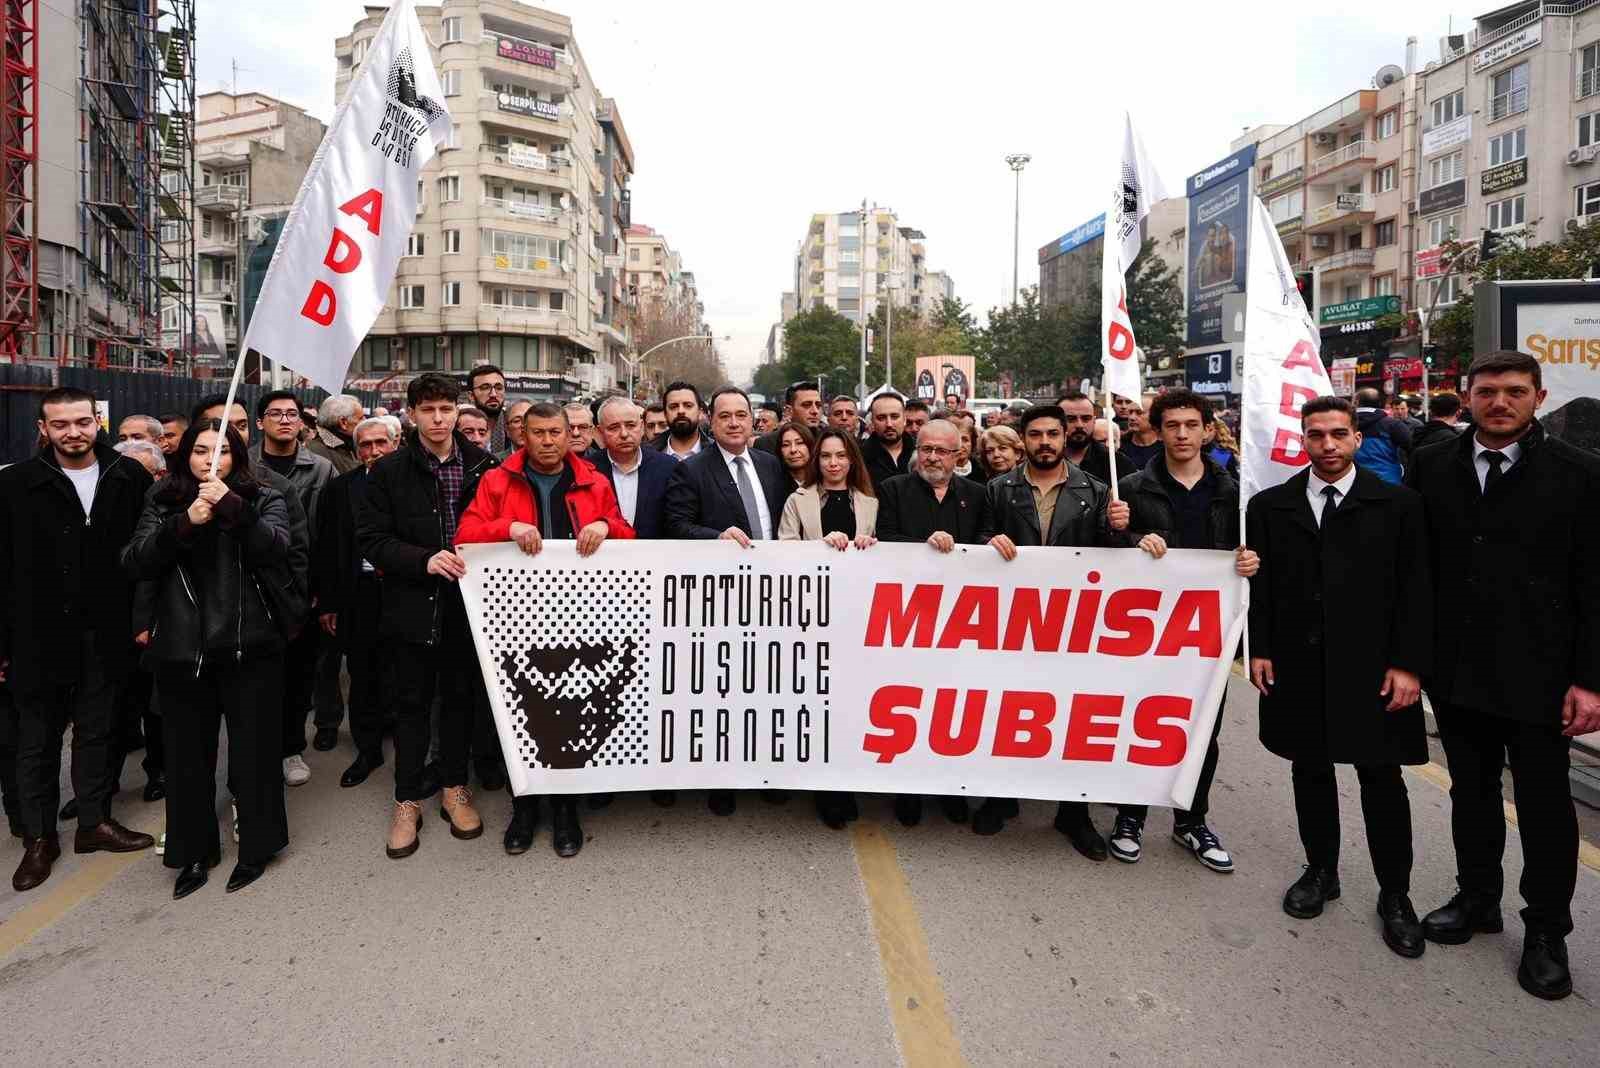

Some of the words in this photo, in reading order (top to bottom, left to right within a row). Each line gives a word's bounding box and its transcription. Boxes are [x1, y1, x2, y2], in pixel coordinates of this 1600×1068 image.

[1324, 301, 1363, 316] AVUKAT
[522, 381, 551, 391] Telekom
[663, 565, 830, 632] ATATÜRKÇÜ
[864, 570, 1223, 659] MANİSA
[662, 631, 830, 699] DÜŞÜNCE
[660, 699, 830, 763] DERNEĞİ
[863, 684, 1193, 768] ŞUBES
